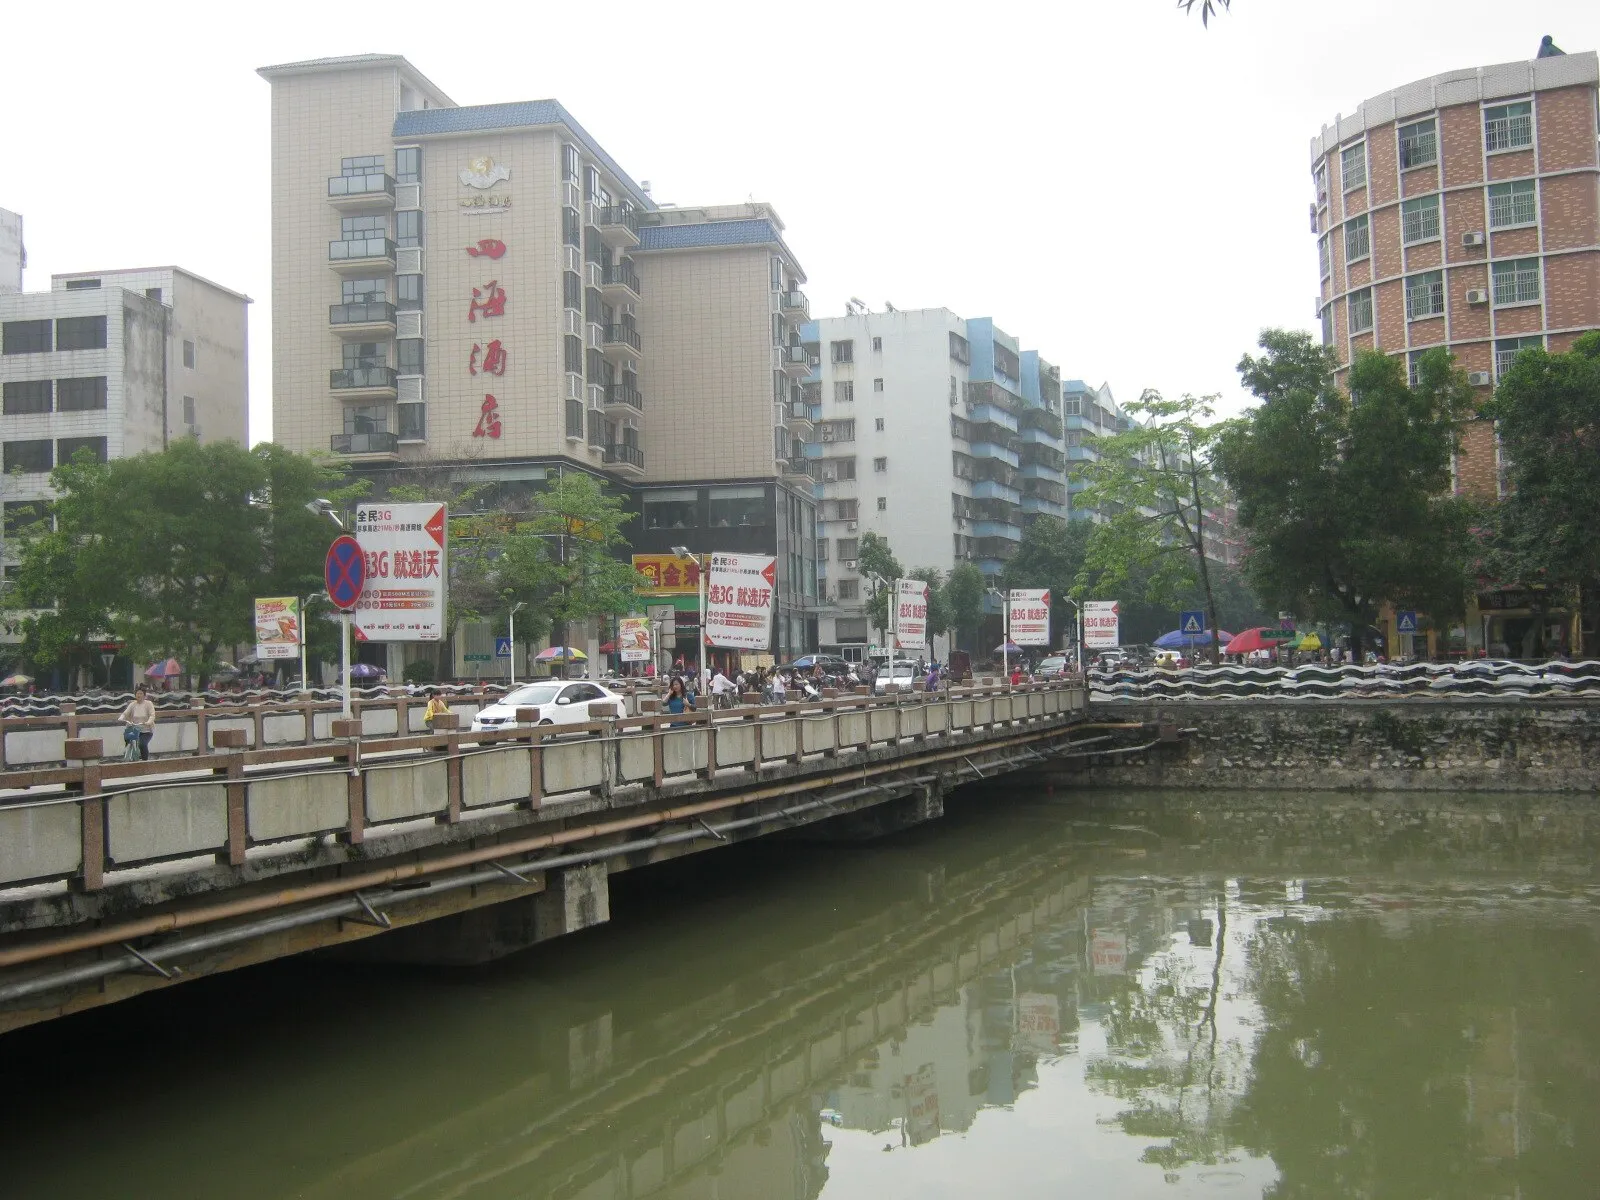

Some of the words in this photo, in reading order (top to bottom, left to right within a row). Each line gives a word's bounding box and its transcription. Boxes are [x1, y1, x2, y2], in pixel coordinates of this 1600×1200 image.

[465, 238, 508, 440] 四海酒店
[357, 510, 392, 522] 全民3G
[394, 549, 440, 579] 就选沃
[711, 556, 738, 566] 全民3G
[709, 584, 734, 604] 选3G
[736, 586, 771, 608] 就选沃
